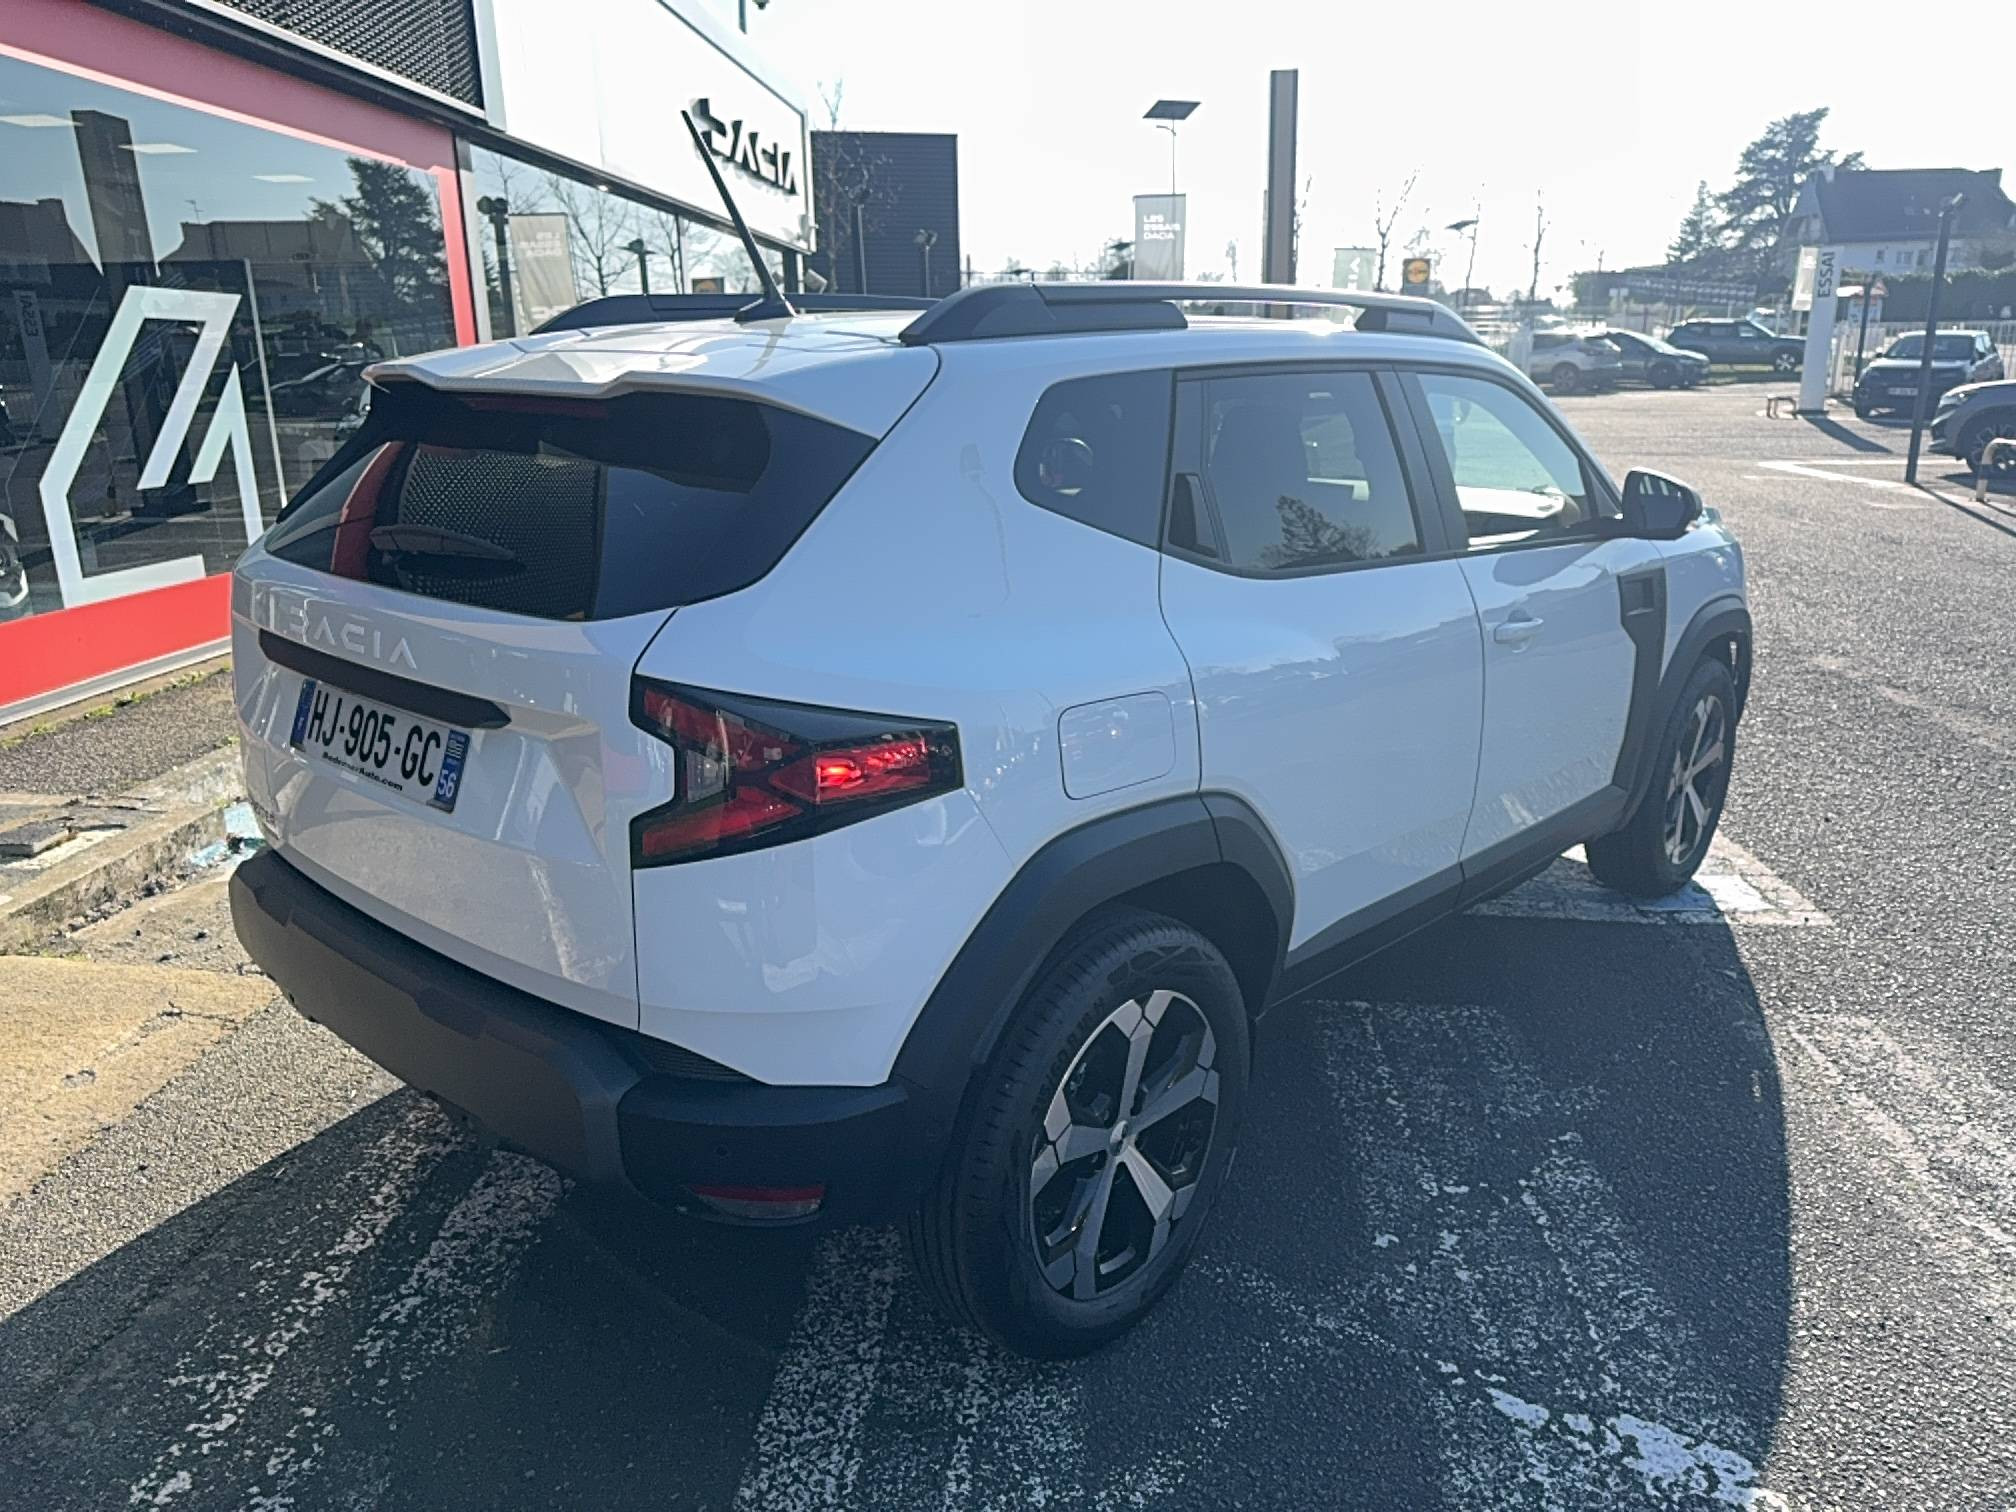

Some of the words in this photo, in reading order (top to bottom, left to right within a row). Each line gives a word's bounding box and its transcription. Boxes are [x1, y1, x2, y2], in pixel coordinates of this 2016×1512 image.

[1817, 251, 1835, 298] ESSAI
[307, 689, 441, 786] HJ-905-GC
[437, 769, 457, 798] 56
